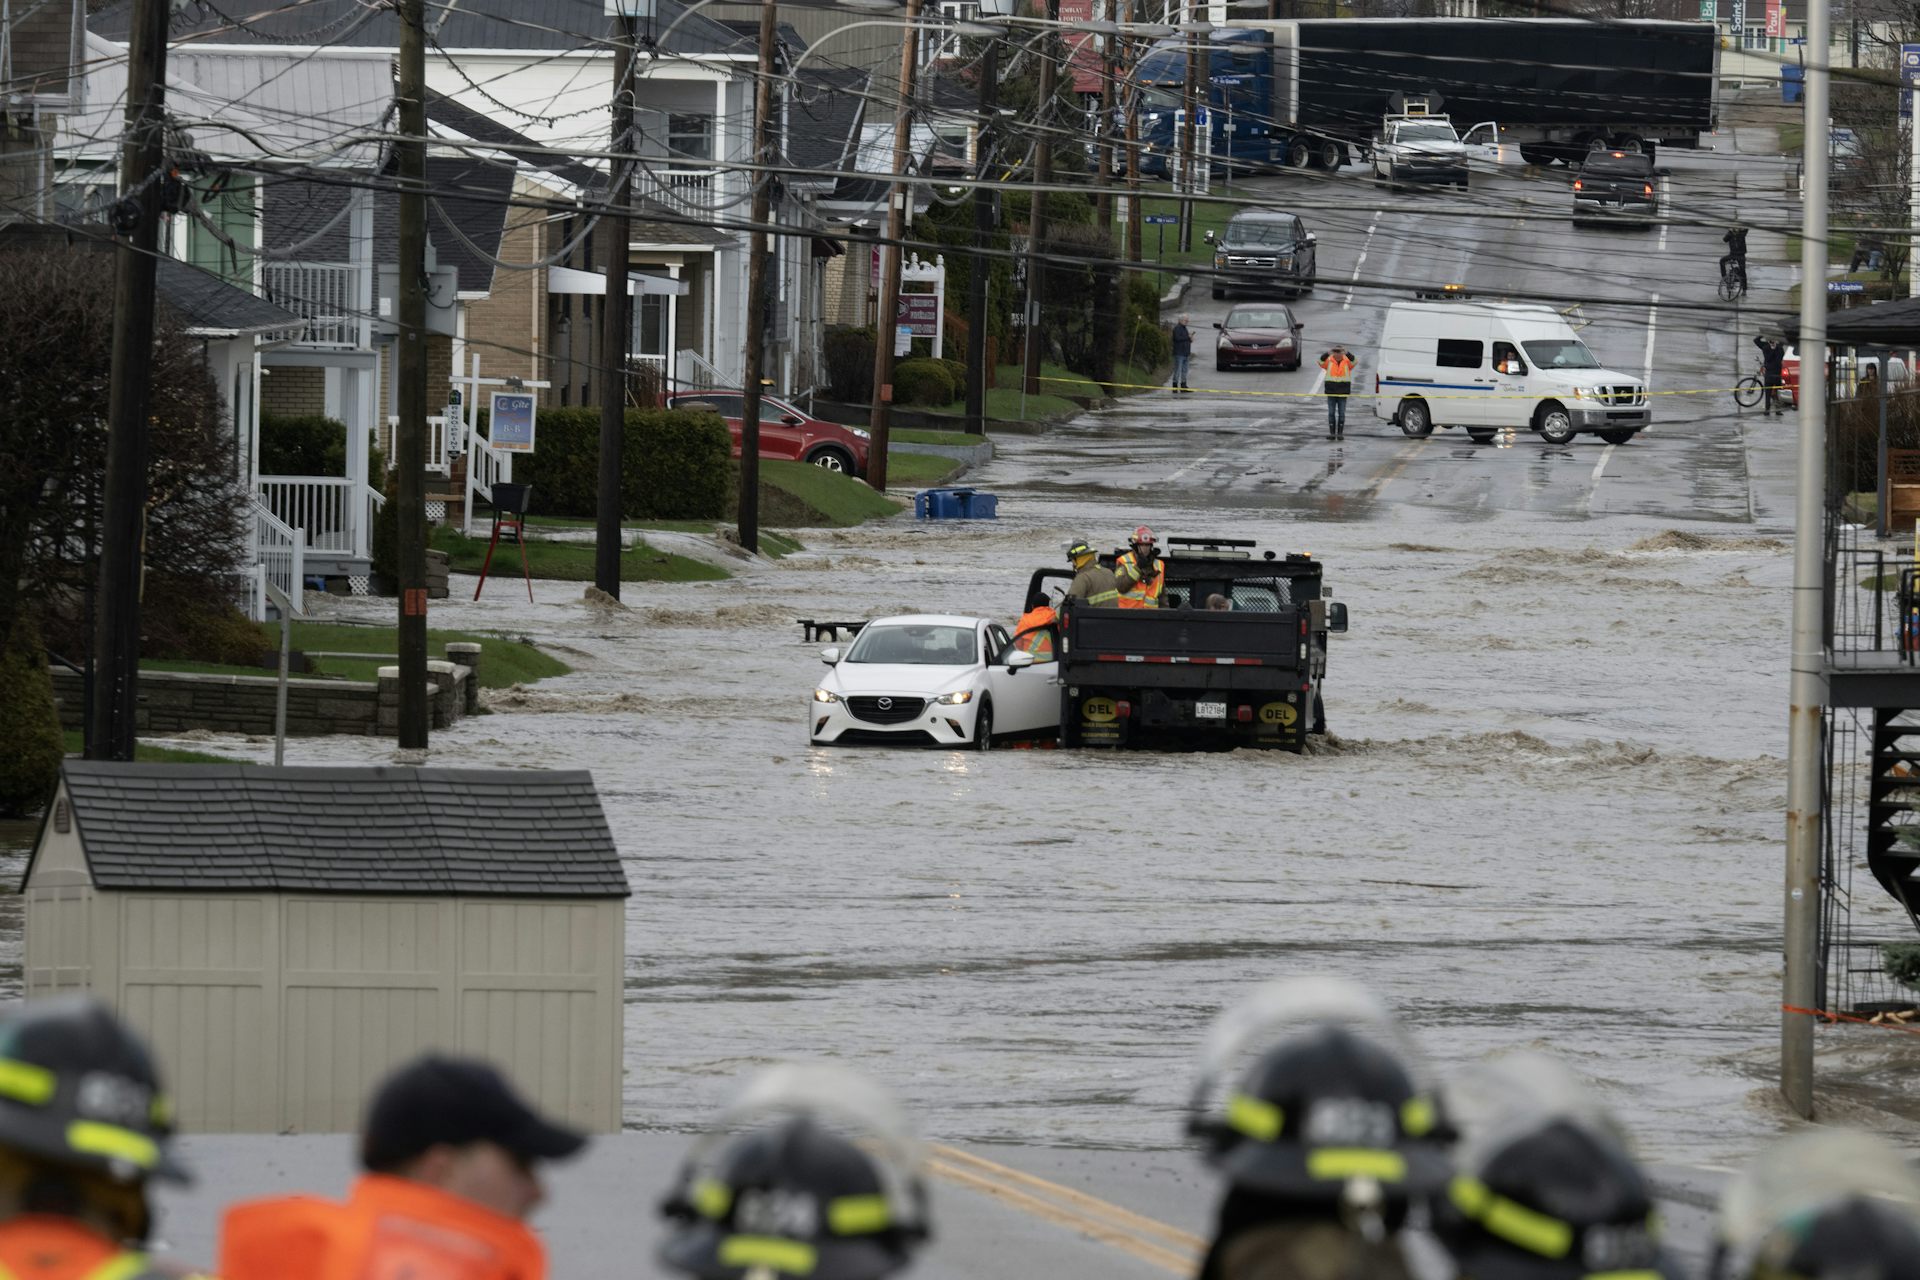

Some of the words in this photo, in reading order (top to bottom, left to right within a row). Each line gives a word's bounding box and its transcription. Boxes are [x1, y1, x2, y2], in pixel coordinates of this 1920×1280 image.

[1767, 10, 1778, 33] Paul
[1088, 704, 1113, 715] DEL
[1266, 709, 1290, 720] DEL
